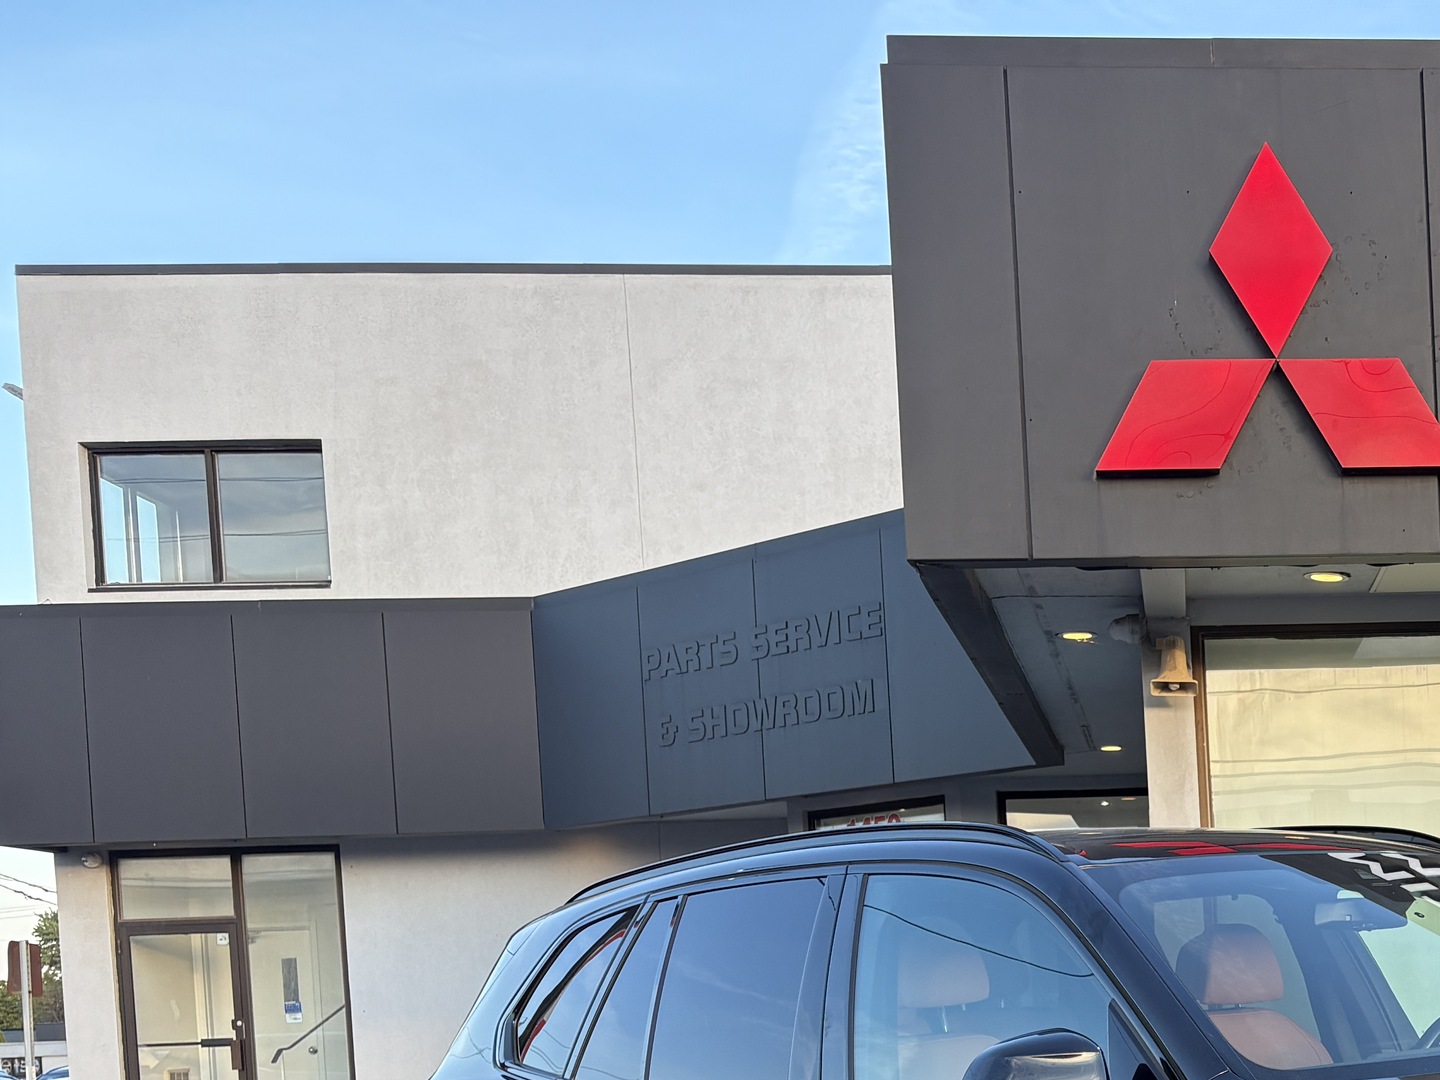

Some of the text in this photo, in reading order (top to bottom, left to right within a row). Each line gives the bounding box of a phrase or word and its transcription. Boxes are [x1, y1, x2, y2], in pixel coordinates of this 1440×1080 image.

[644, 602, 884, 682] PARTS SERVICE
[659, 678, 877, 748] & SHOWROOM
